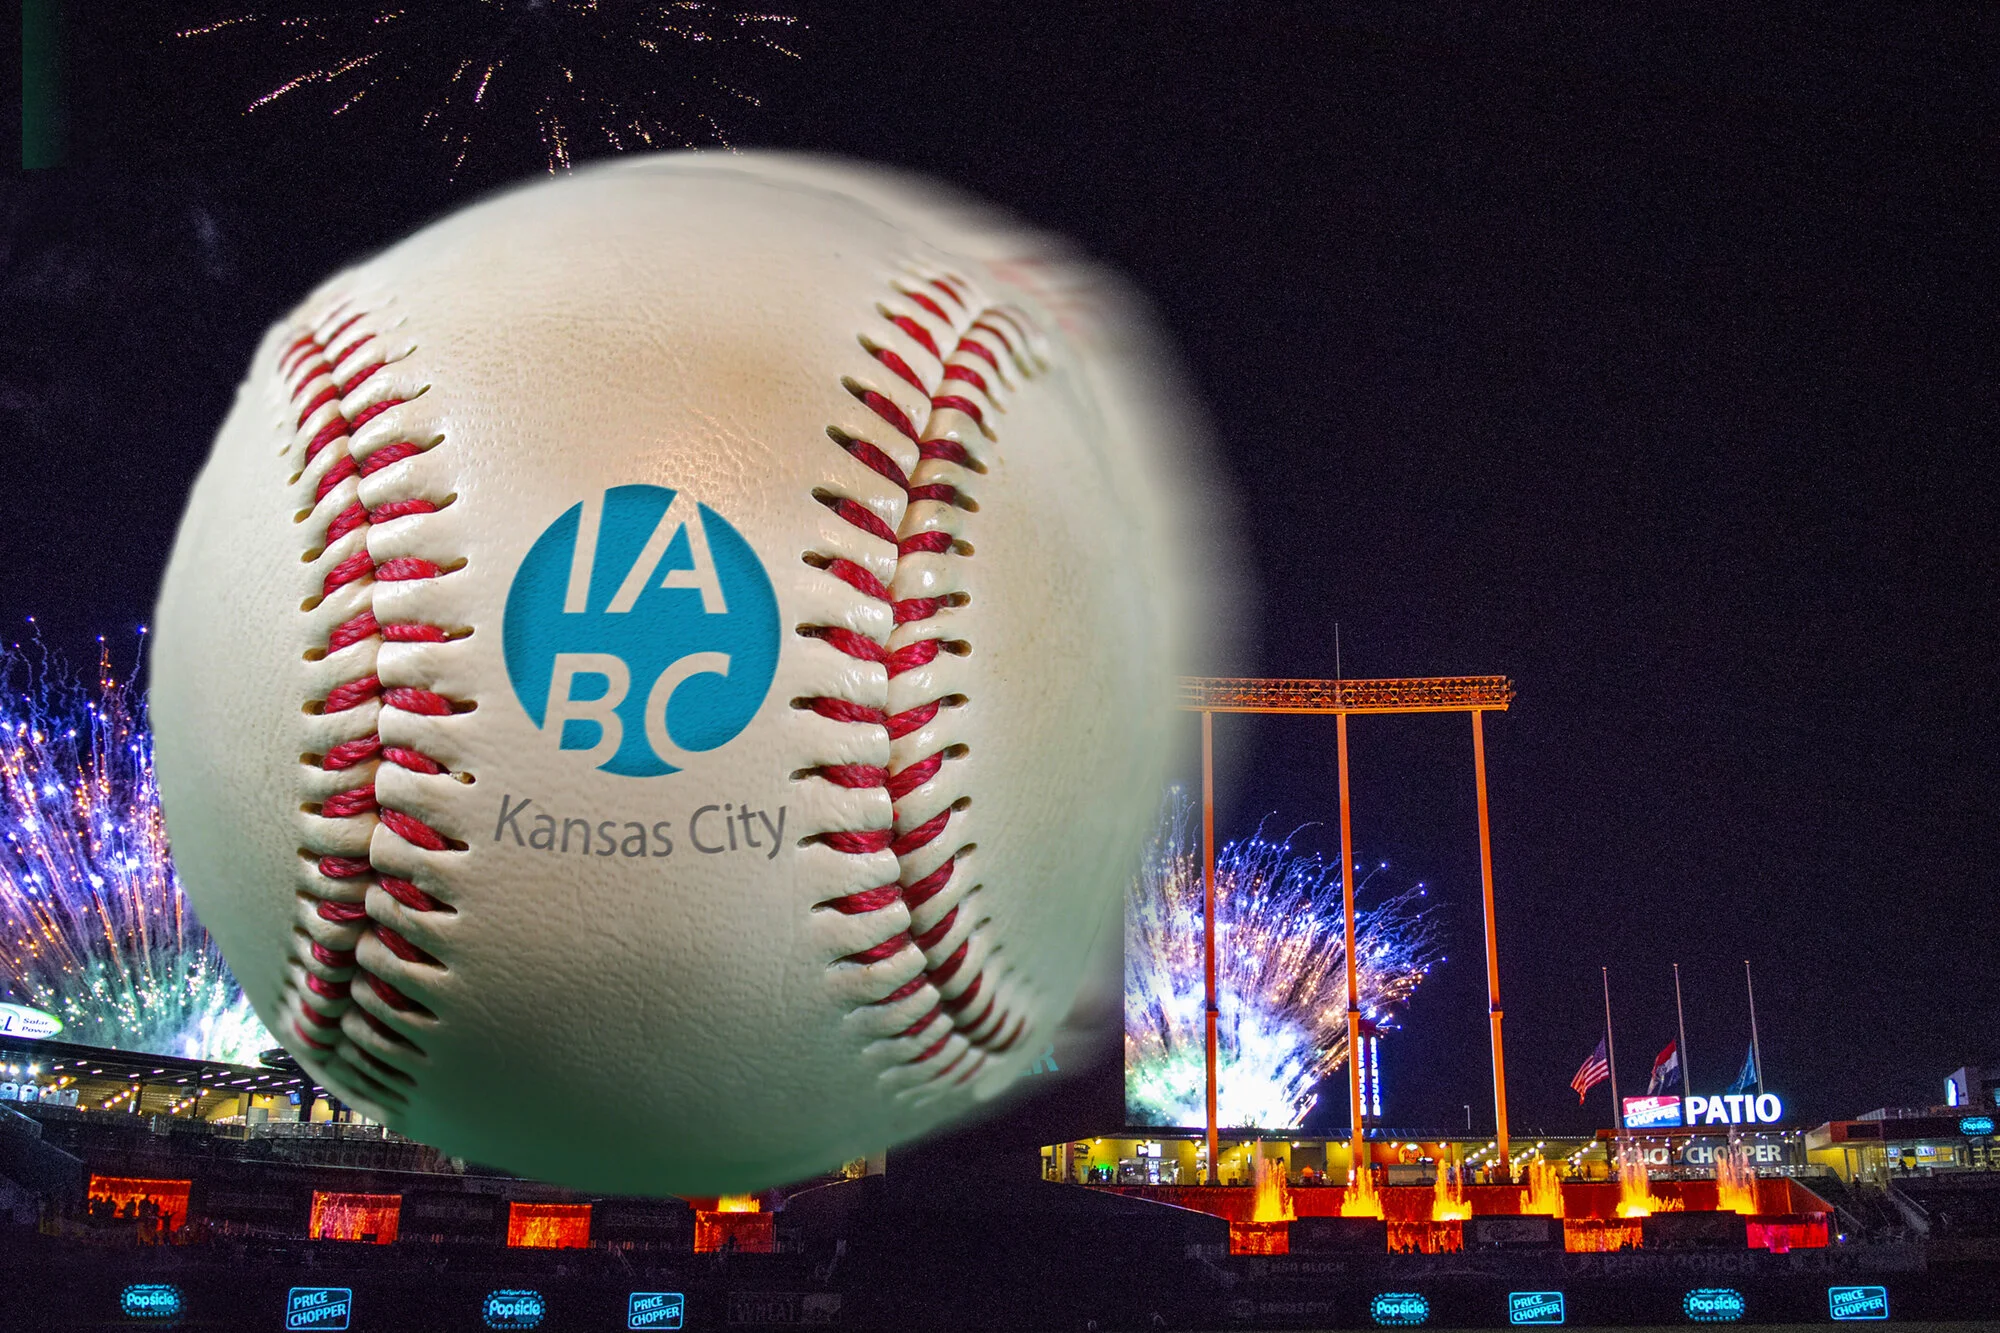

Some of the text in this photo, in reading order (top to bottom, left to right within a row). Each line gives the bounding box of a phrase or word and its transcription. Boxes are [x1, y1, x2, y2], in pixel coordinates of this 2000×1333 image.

[494, 794, 787, 860] Kansas City
[22, 1026, 53, 1035] Power
[23, 1018, 49, 1026] Solar
[1626, 1096, 1660, 1114] PRICE
[1685, 1093, 1782, 1125] PATIO
[1627, 1106, 1680, 1127] CHOPPER
[126, 1292, 175, 1308] Popsicle
[293, 1291, 328, 1309] PRICE
[633, 1295, 664, 1312] PRICE
[1513, 1294, 1543, 1309] PRICE
[1689, 1296, 1740, 1313] Popsicle
[1833, 1289, 1865, 1304] PRICE
[290, 1303, 347, 1326] CHOPPER
[489, 1299, 541, 1318] Popsicle
[631, 1306, 680, 1326] CHOPPER
[1376, 1301, 1425, 1317] Popsicle
[1513, 1303, 1561, 1321] CHOPPER
[1834, 1298, 1884, 1317] CHOPPER
